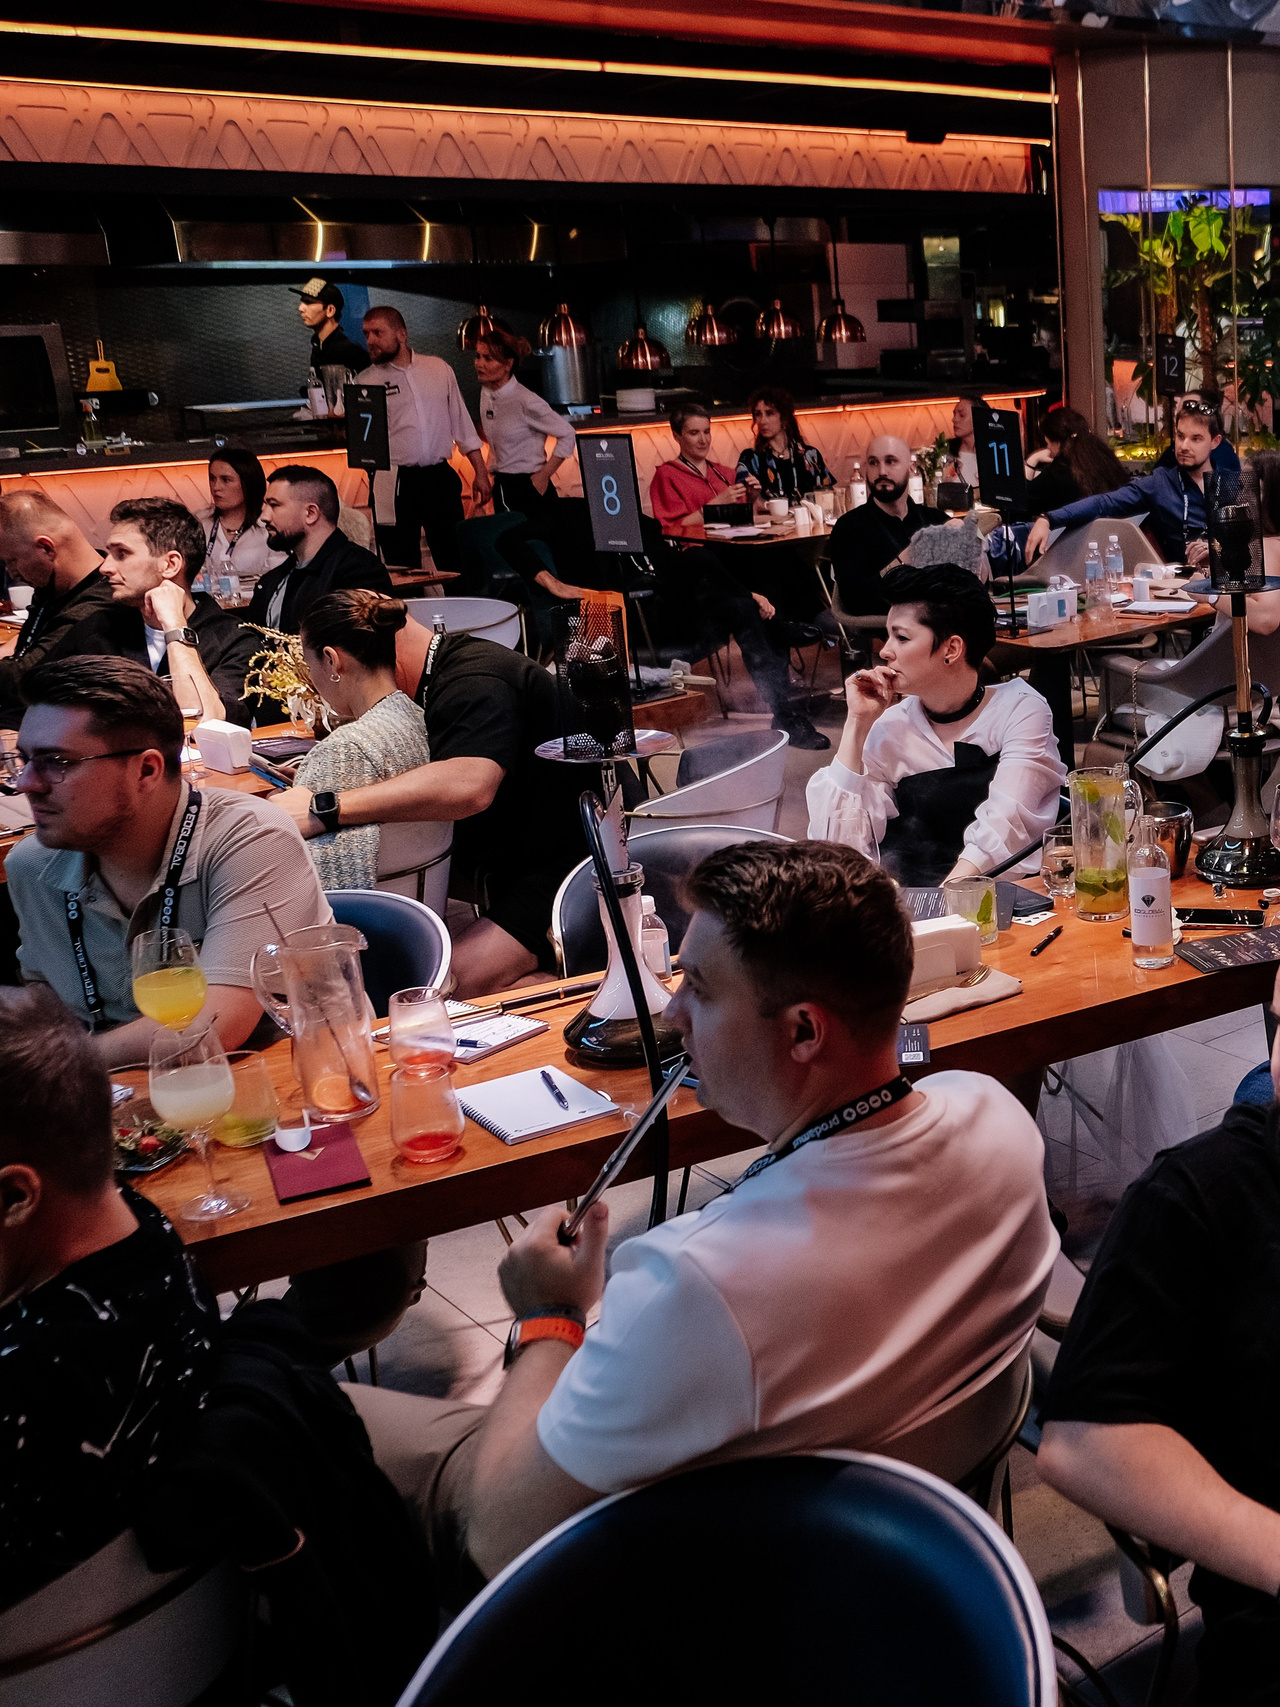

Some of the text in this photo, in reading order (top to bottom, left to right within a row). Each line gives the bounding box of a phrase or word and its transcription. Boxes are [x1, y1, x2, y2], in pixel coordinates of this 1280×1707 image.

[1162, 355, 1178, 377] 12
[360, 413, 372, 442] 7
[988, 441, 1010, 477] 11
[601, 475, 620, 516] 8
[170, 813, 196, 870] EDGLOBAL
